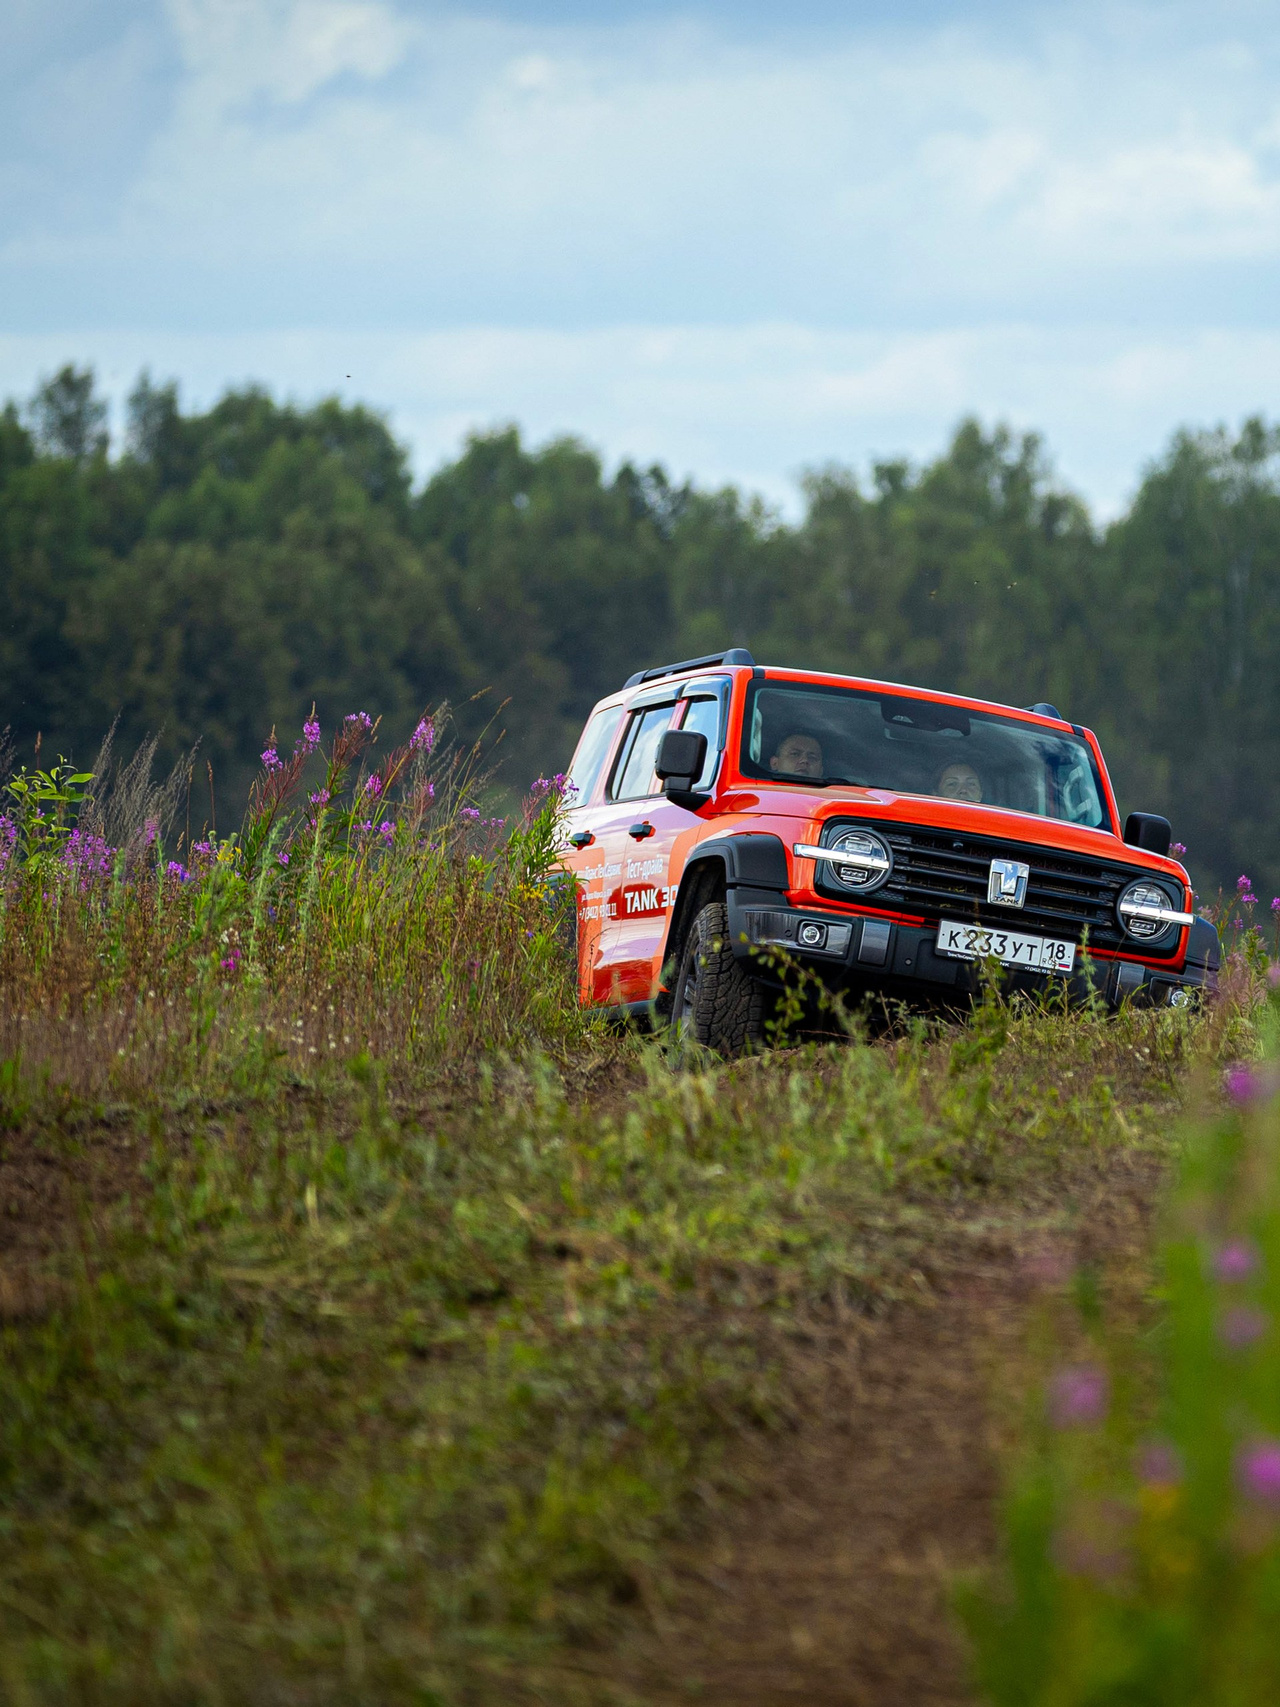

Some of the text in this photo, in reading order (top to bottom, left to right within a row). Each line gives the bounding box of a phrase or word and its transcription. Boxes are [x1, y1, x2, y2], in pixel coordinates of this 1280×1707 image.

[627, 854, 663, 880] Тест-драйв
[624, 888, 659, 913] TANK
[994, 895, 1019, 905] TANK
[1046, 942, 1066, 960] 18
